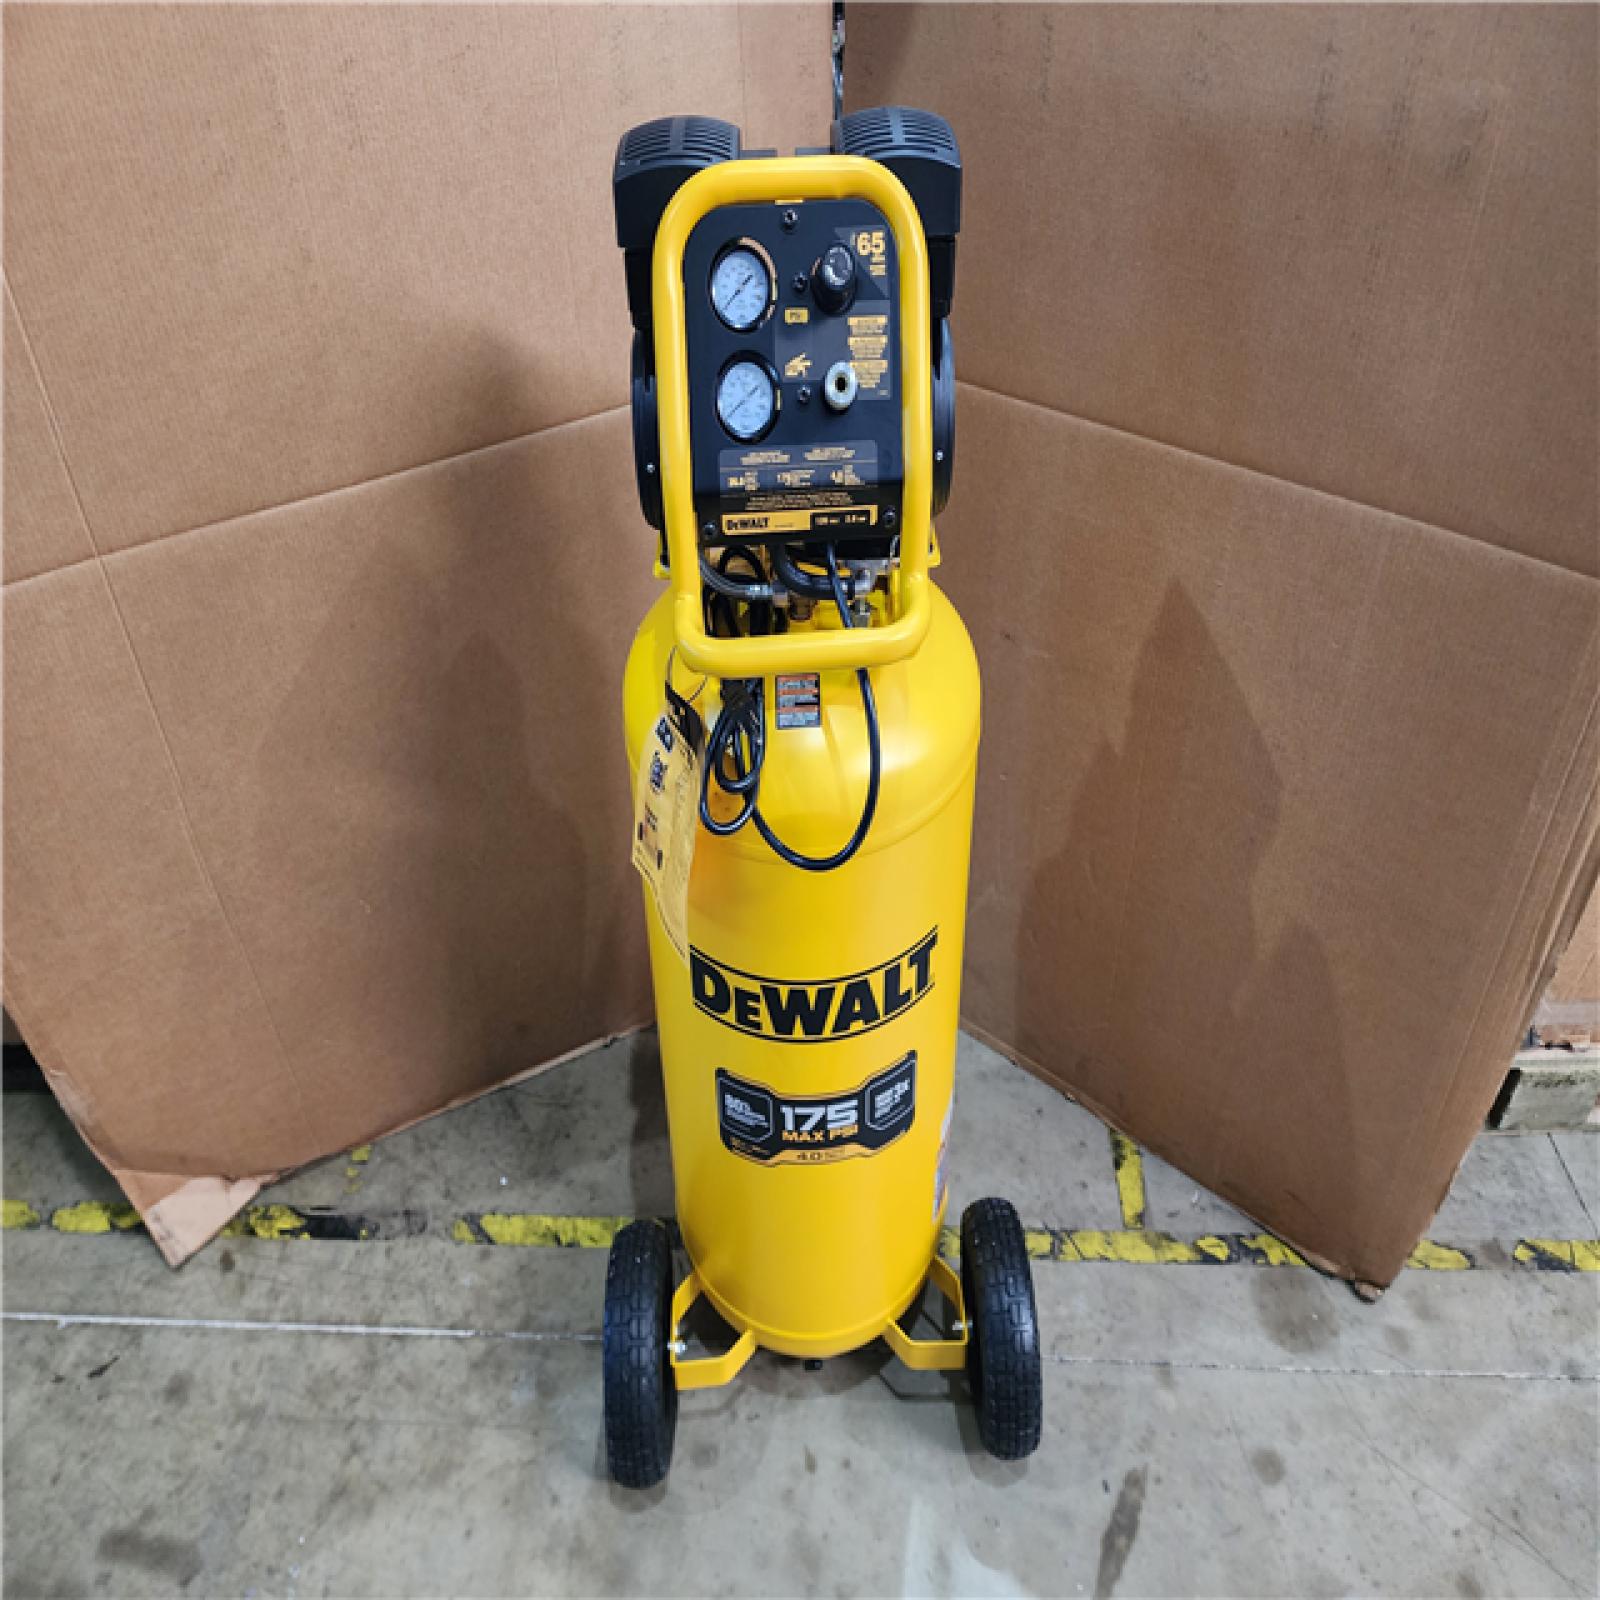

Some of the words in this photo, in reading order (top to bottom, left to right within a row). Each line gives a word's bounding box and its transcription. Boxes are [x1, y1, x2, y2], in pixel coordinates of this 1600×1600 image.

[857, 230, 886, 256] 65
[780, 1100, 859, 1132] 175
[782, 1129, 825, 1143] MAX
